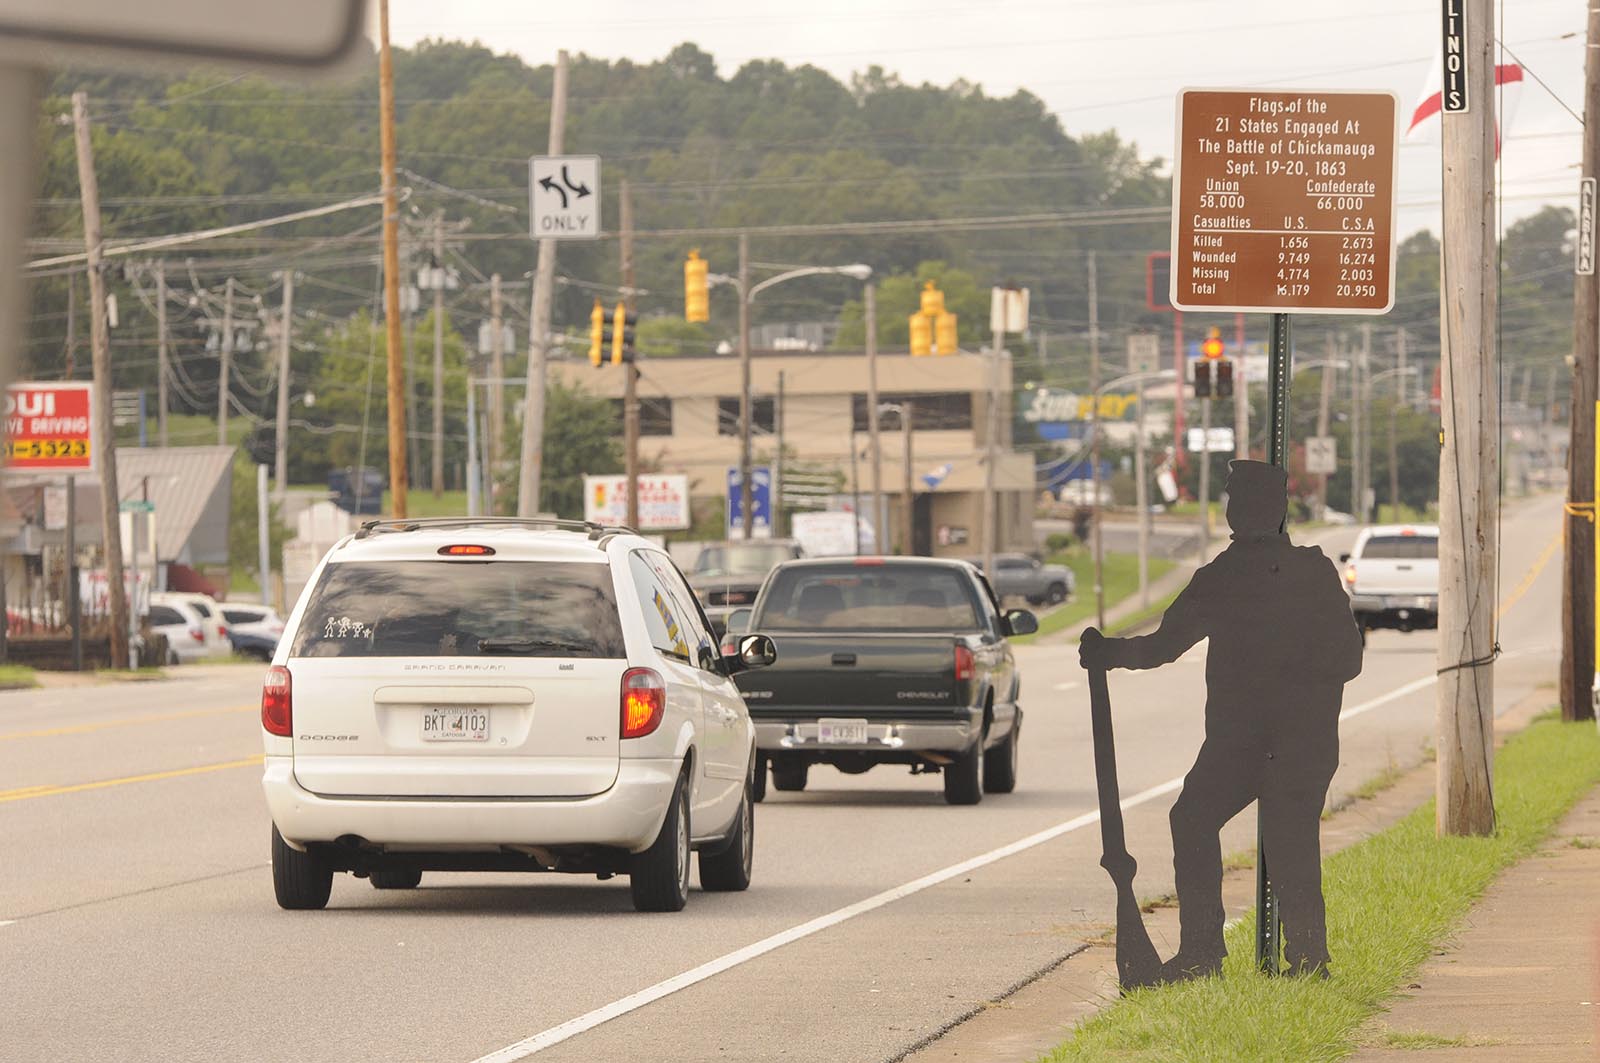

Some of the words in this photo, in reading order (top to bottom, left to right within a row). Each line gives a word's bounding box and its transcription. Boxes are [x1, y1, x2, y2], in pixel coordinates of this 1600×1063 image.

[1250, 98, 1284, 116] Flags
[1289, 98, 1302, 113] of
[1306, 99, 1328, 113] the
[1215, 117, 1230, 132] 21
[1239, 118, 1279, 133] States
[1284, 119, 1339, 138] Engaged
[1344, 120, 1360, 134] At
[1198, 138, 1221, 153] The
[1226, 139, 1265, 154] Battle
[1270, 140, 1283, 154] of
[1288, 140, 1376, 159] Chickamauga
[1226, 160, 1259, 178] Sept.
[1315, 161, 1346, 176] 1863
[1206, 178, 1240, 191] Union
[1306, 179, 1376, 193] Confederate
[541, 215, 589, 231] ONLY
[1193, 214, 1252, 229] Casualties
[1284, 216, 1309, 230] U.S.
[1342, 217, 1375, 230] C.S.A
[1579, 181, 1593, 273] ALABAMA
[1193, 235, 1223, 247] Killed
[1192, 251, 1237, 263] Wounded
[1192, 266, 1230, 282] Missing
[1191, 282, 1216, 294] Total
[424, 714, 446, 731] BKT
[455, 714, 486, 731] 4103
[299, 734, 360, 742] DODGE
